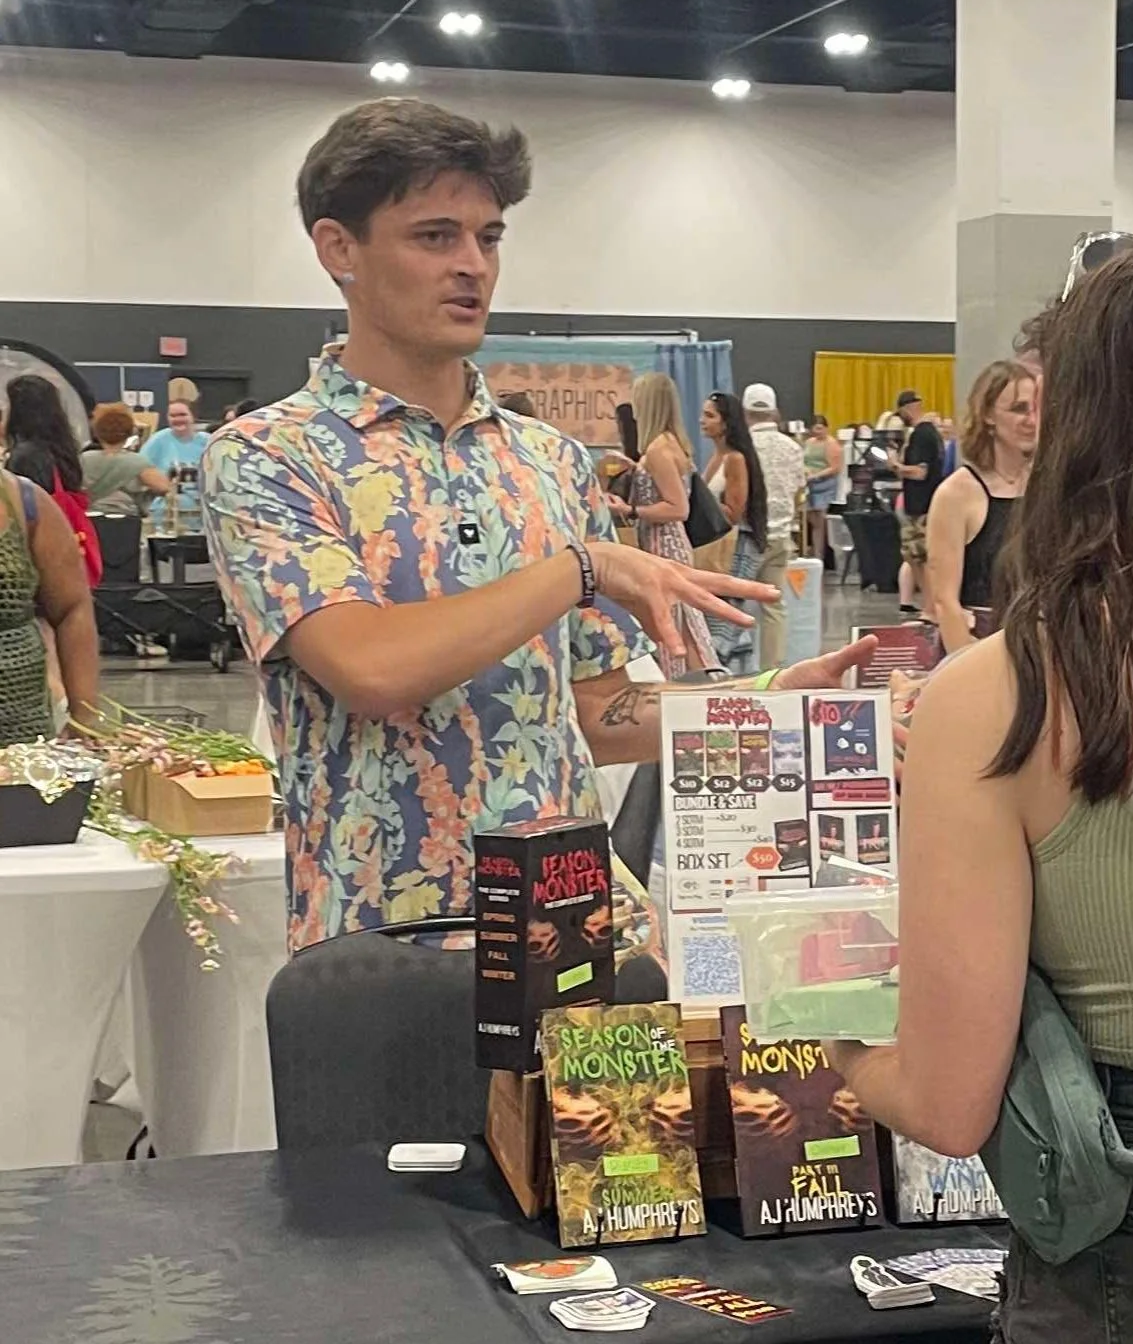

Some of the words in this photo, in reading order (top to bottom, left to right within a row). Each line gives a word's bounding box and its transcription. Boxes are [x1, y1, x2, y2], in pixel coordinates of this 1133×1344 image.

[674, 796, 718, 810] BUNDLE
[727, 795, 755, 809] SAVE
[541, 847, 598, 872] SEASON
[677, 854, 706, 870] BOX
[707, 853, 731, 870] SET
[532, 868, 609, 905] MONSTER
[487, 950, 510, 961] FALL
[560, 1022, 651, 1050] SEASON
[650, 1026, 667, 1040] OF
[652, 1039, 676, 1052] THE
[563, 1049, 689, 1083] MONSTER
[740, 1043, 830, 1080] MONST
[792, 1164, 823, 1176] PART
[927, 1160, 988, 1193] WINT
[601, 1185, 675, 1208] SUMMER
[790, 1175, 845, 1200] FALL
[783, 1191, 878, 1223] HUMPHREYS
[937, 1188, 1004, 1214] HUMPH
[607, 1198, 701, 1233] HUMPHREYS
